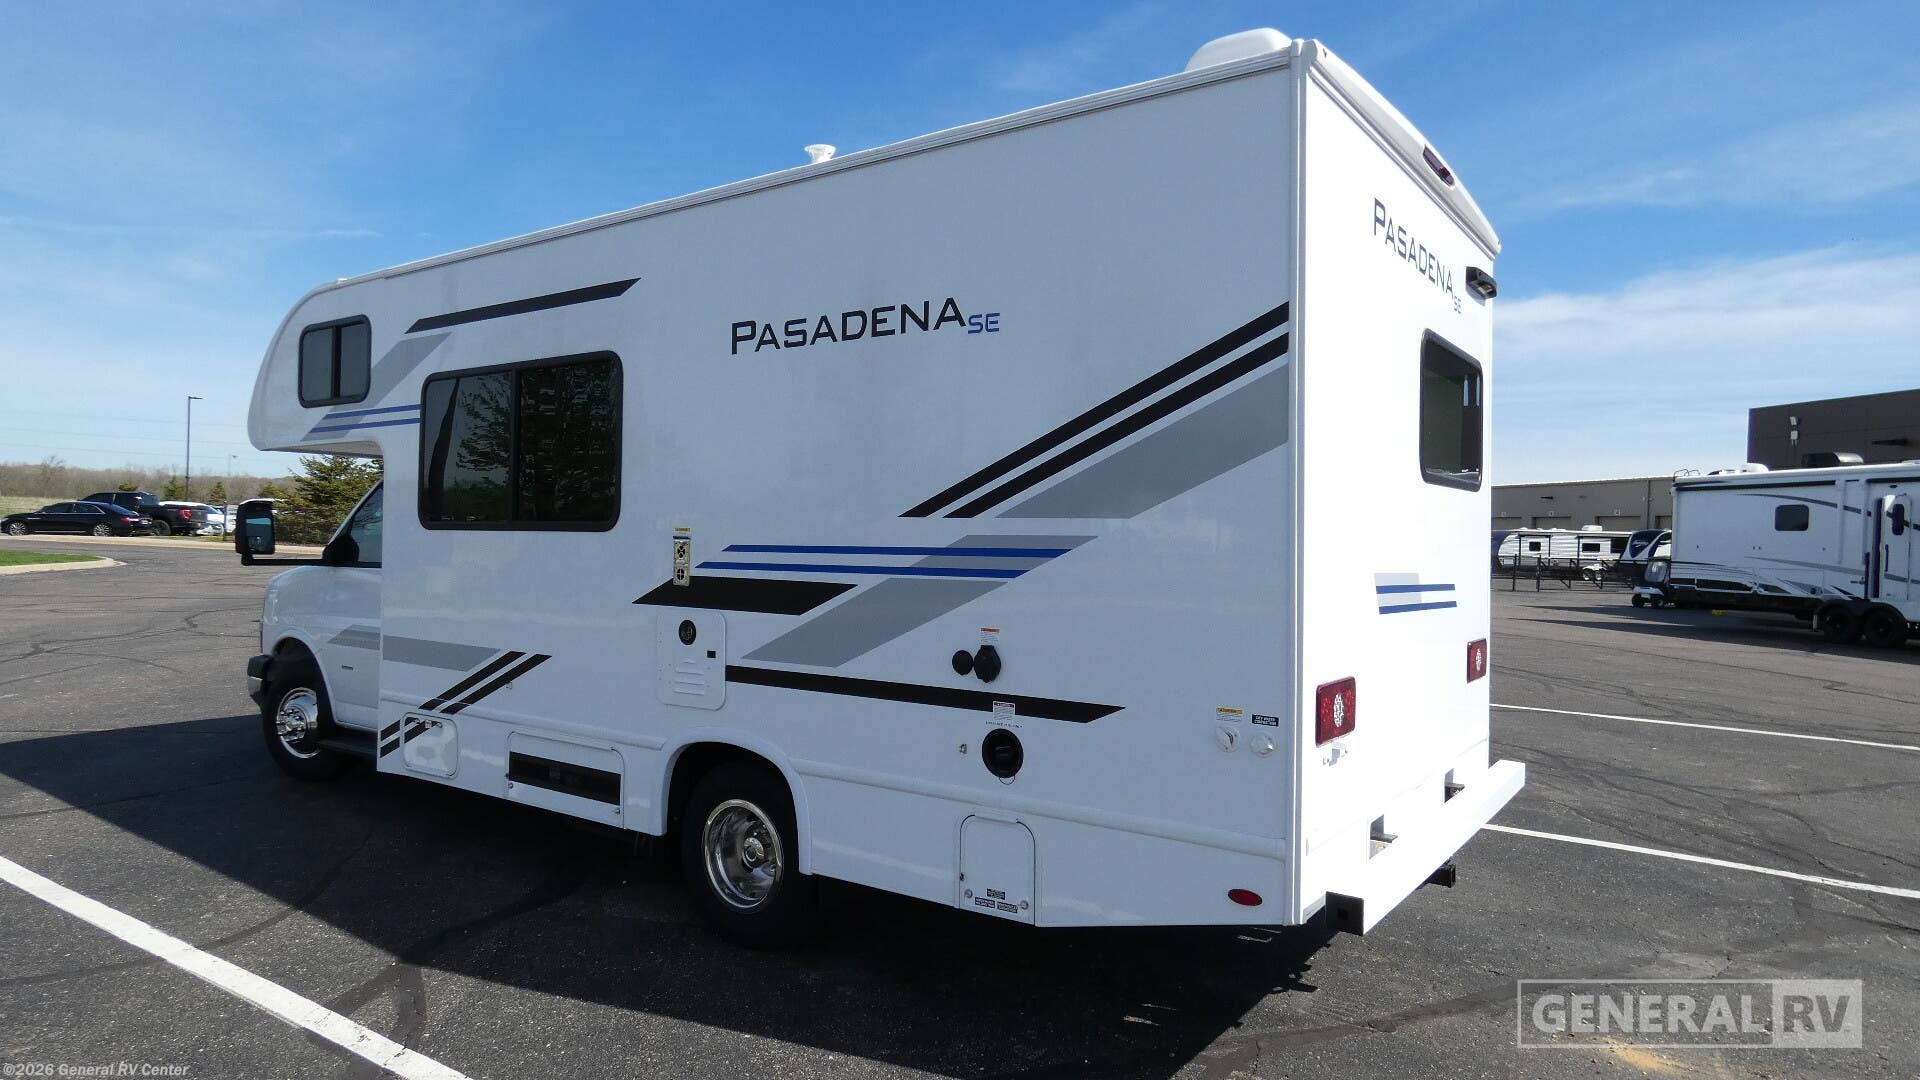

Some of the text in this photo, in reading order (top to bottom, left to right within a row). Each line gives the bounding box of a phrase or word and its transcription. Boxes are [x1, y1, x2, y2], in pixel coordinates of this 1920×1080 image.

[1373, 197, 1462, 314] PASADENA SE
[731, 297, 1000, 355] PASADENA SE
